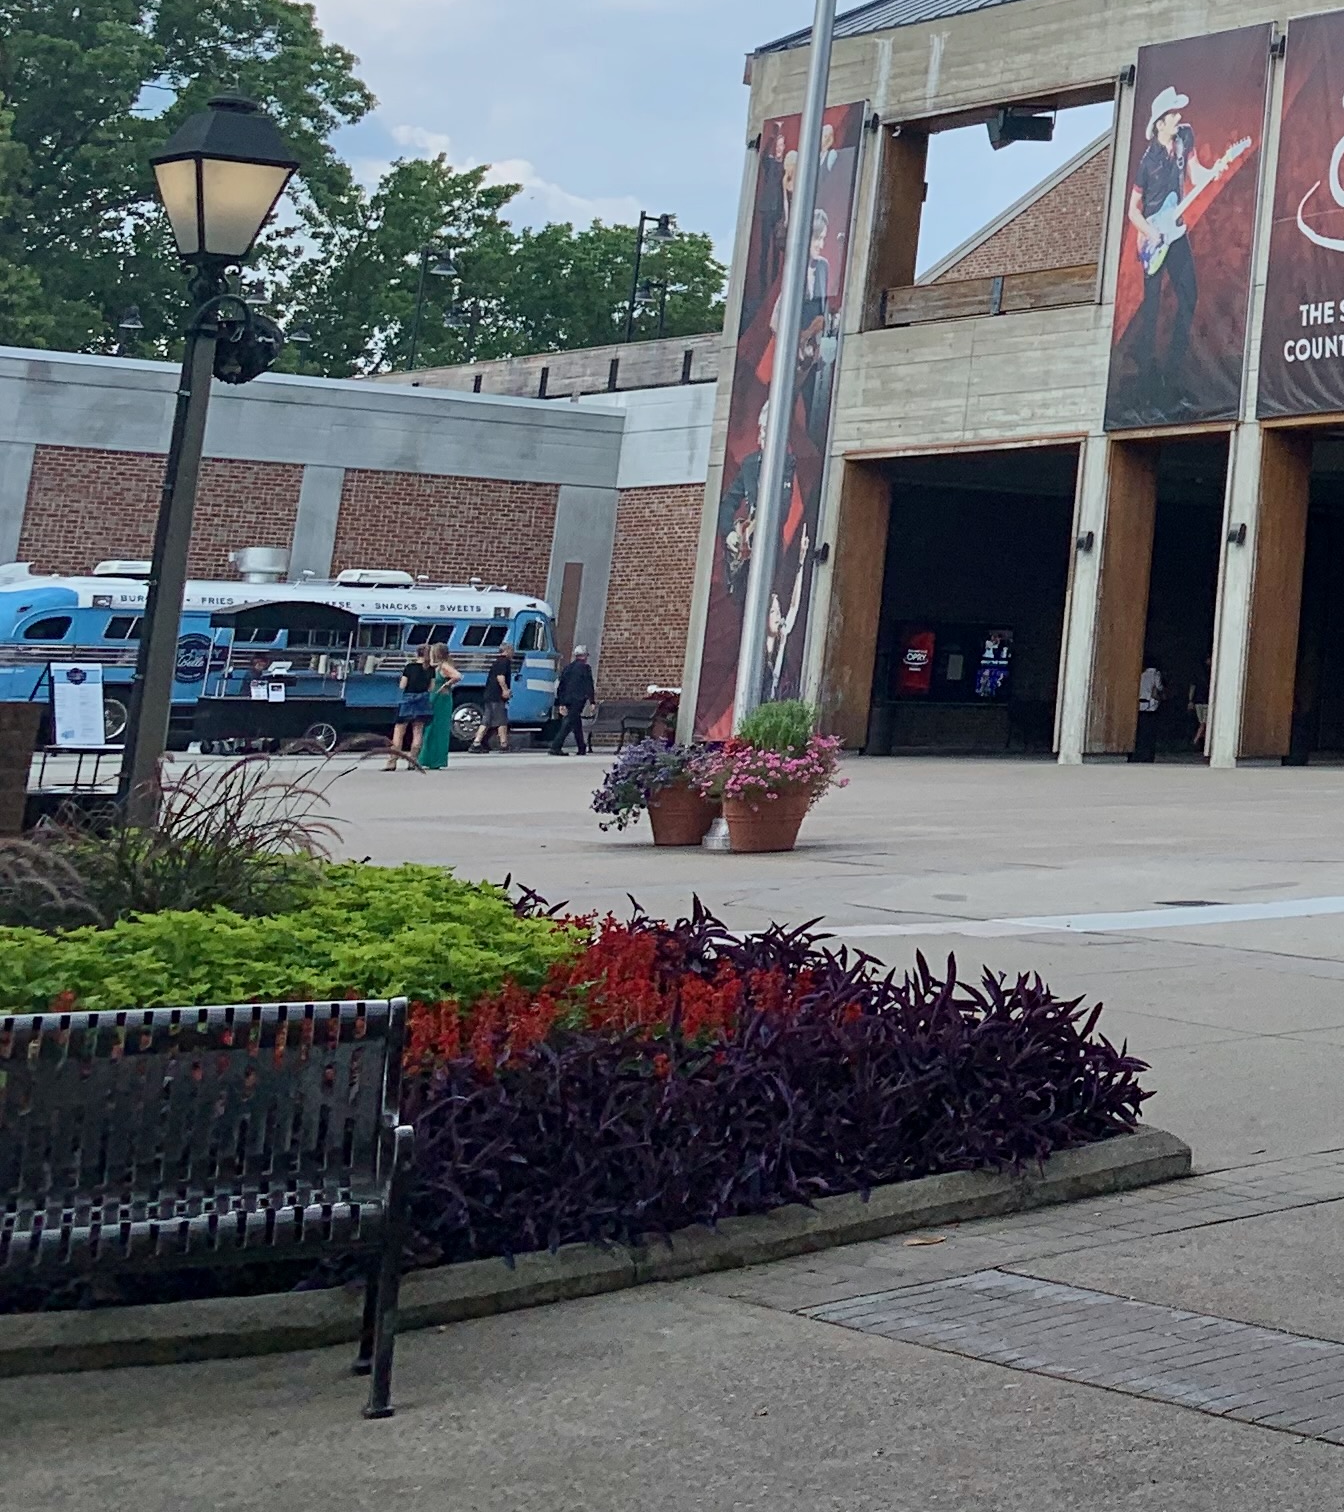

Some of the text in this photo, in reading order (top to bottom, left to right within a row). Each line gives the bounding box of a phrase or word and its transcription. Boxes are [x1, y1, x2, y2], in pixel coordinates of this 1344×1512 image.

[1300, 301, 1335, 326] THE
[201, 597, 234, 605] FRIES
[375, 602, 418, 610] SNACKS
[440, 604, 482, 612] SWEETS
